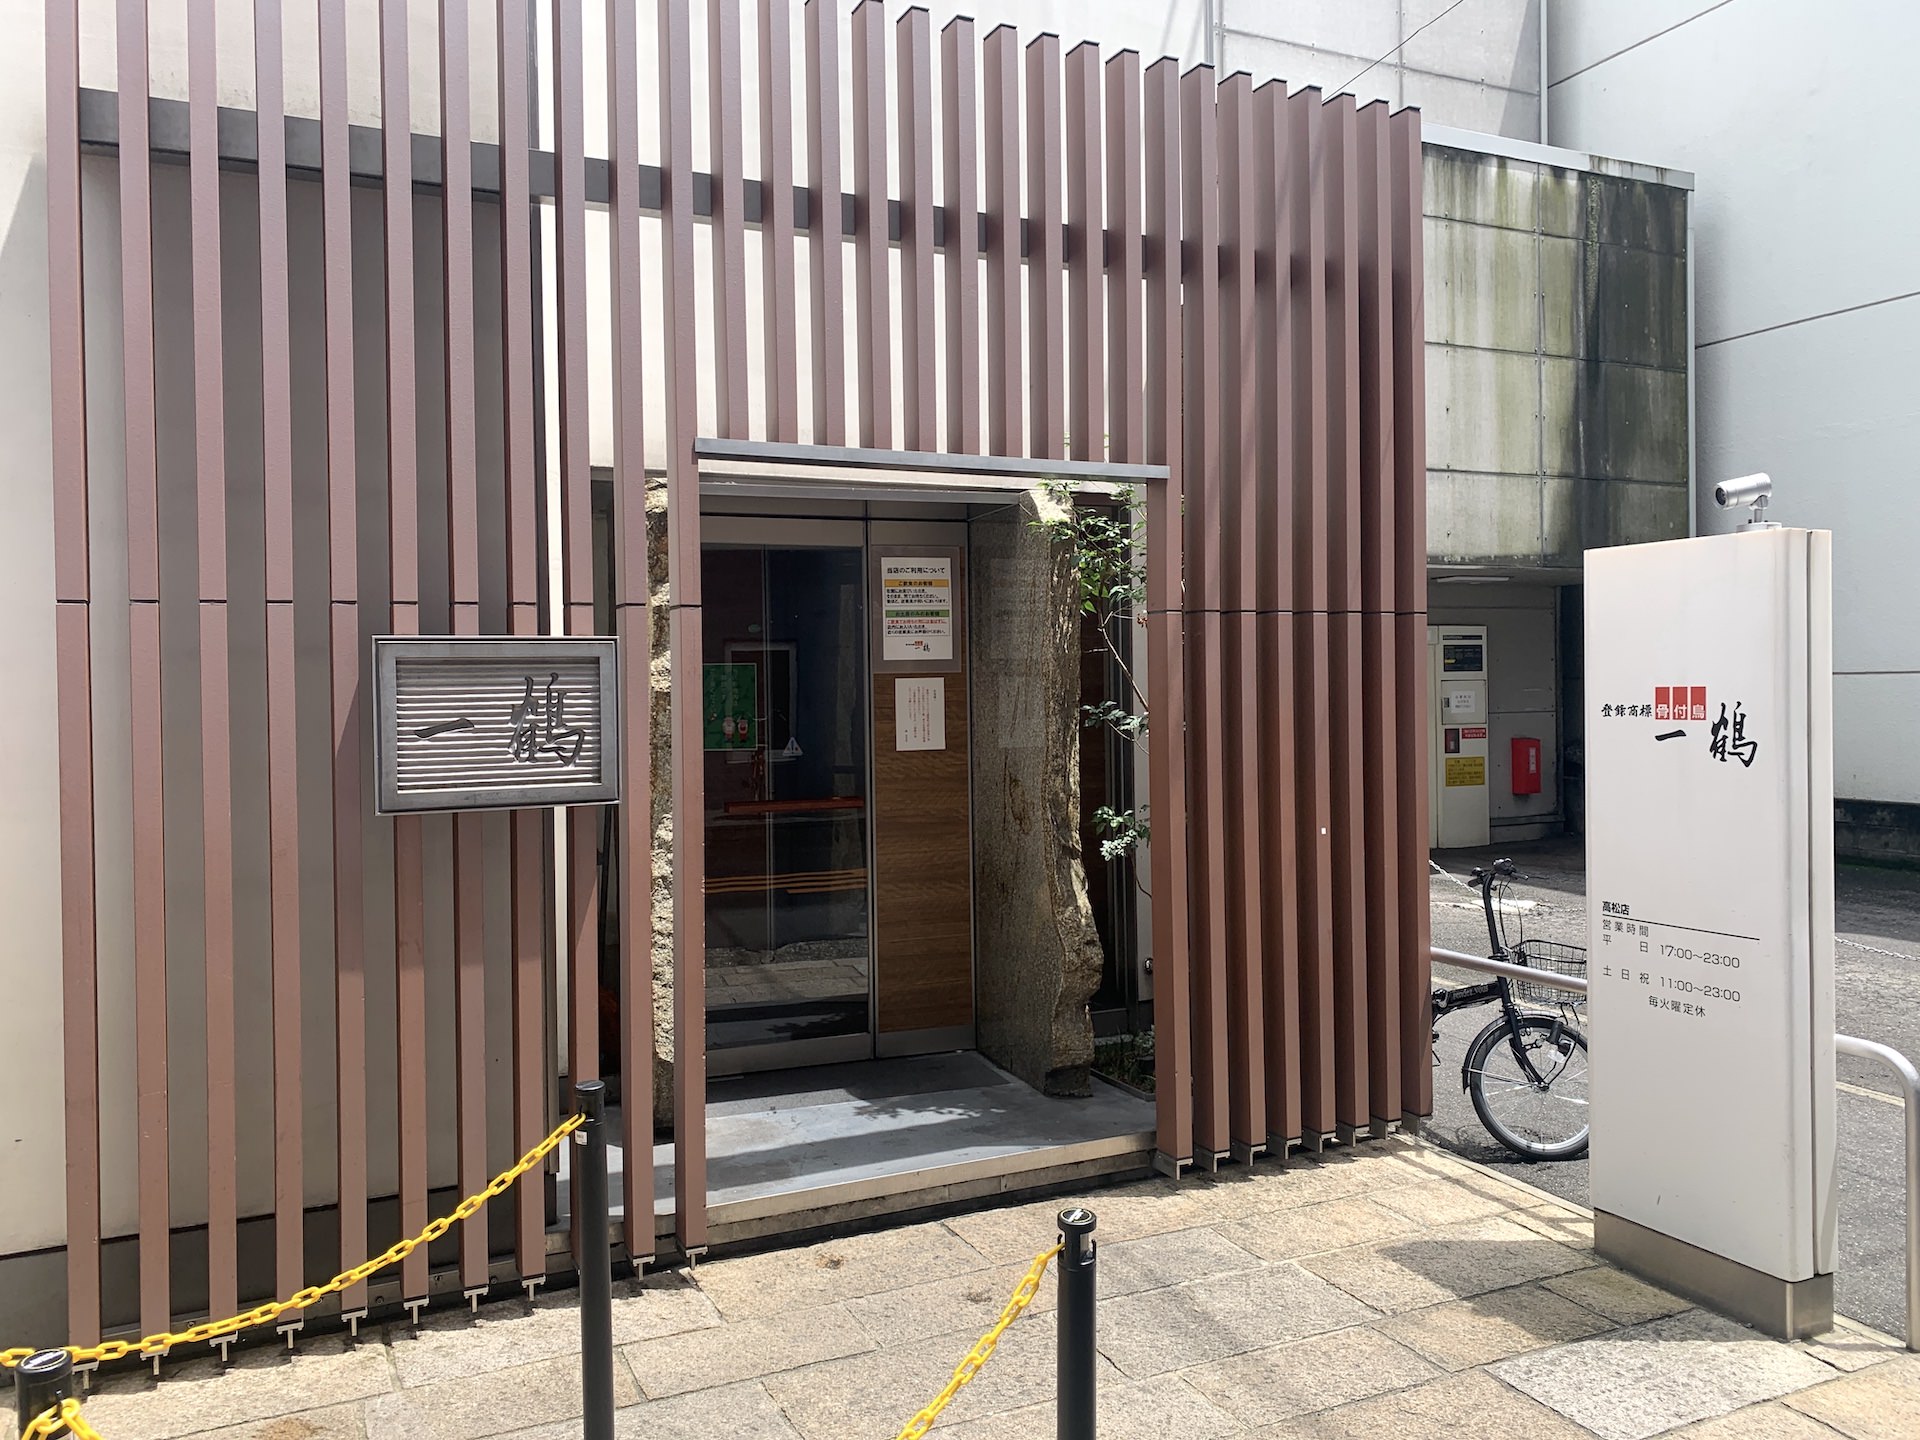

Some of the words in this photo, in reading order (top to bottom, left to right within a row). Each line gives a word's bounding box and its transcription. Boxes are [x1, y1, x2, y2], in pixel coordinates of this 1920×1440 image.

[413, 672, 585, 767] 一鶴
[1656, 704, 1706, 719] 骨付鳥
[1654, 701, 1758, 768] 一鶴
[1602, 901, 1630, 916] 高松店
[1602, 919, 1649, 938] 営業時間
[1648, 995, 1706, 1018] 毎火曜定休
